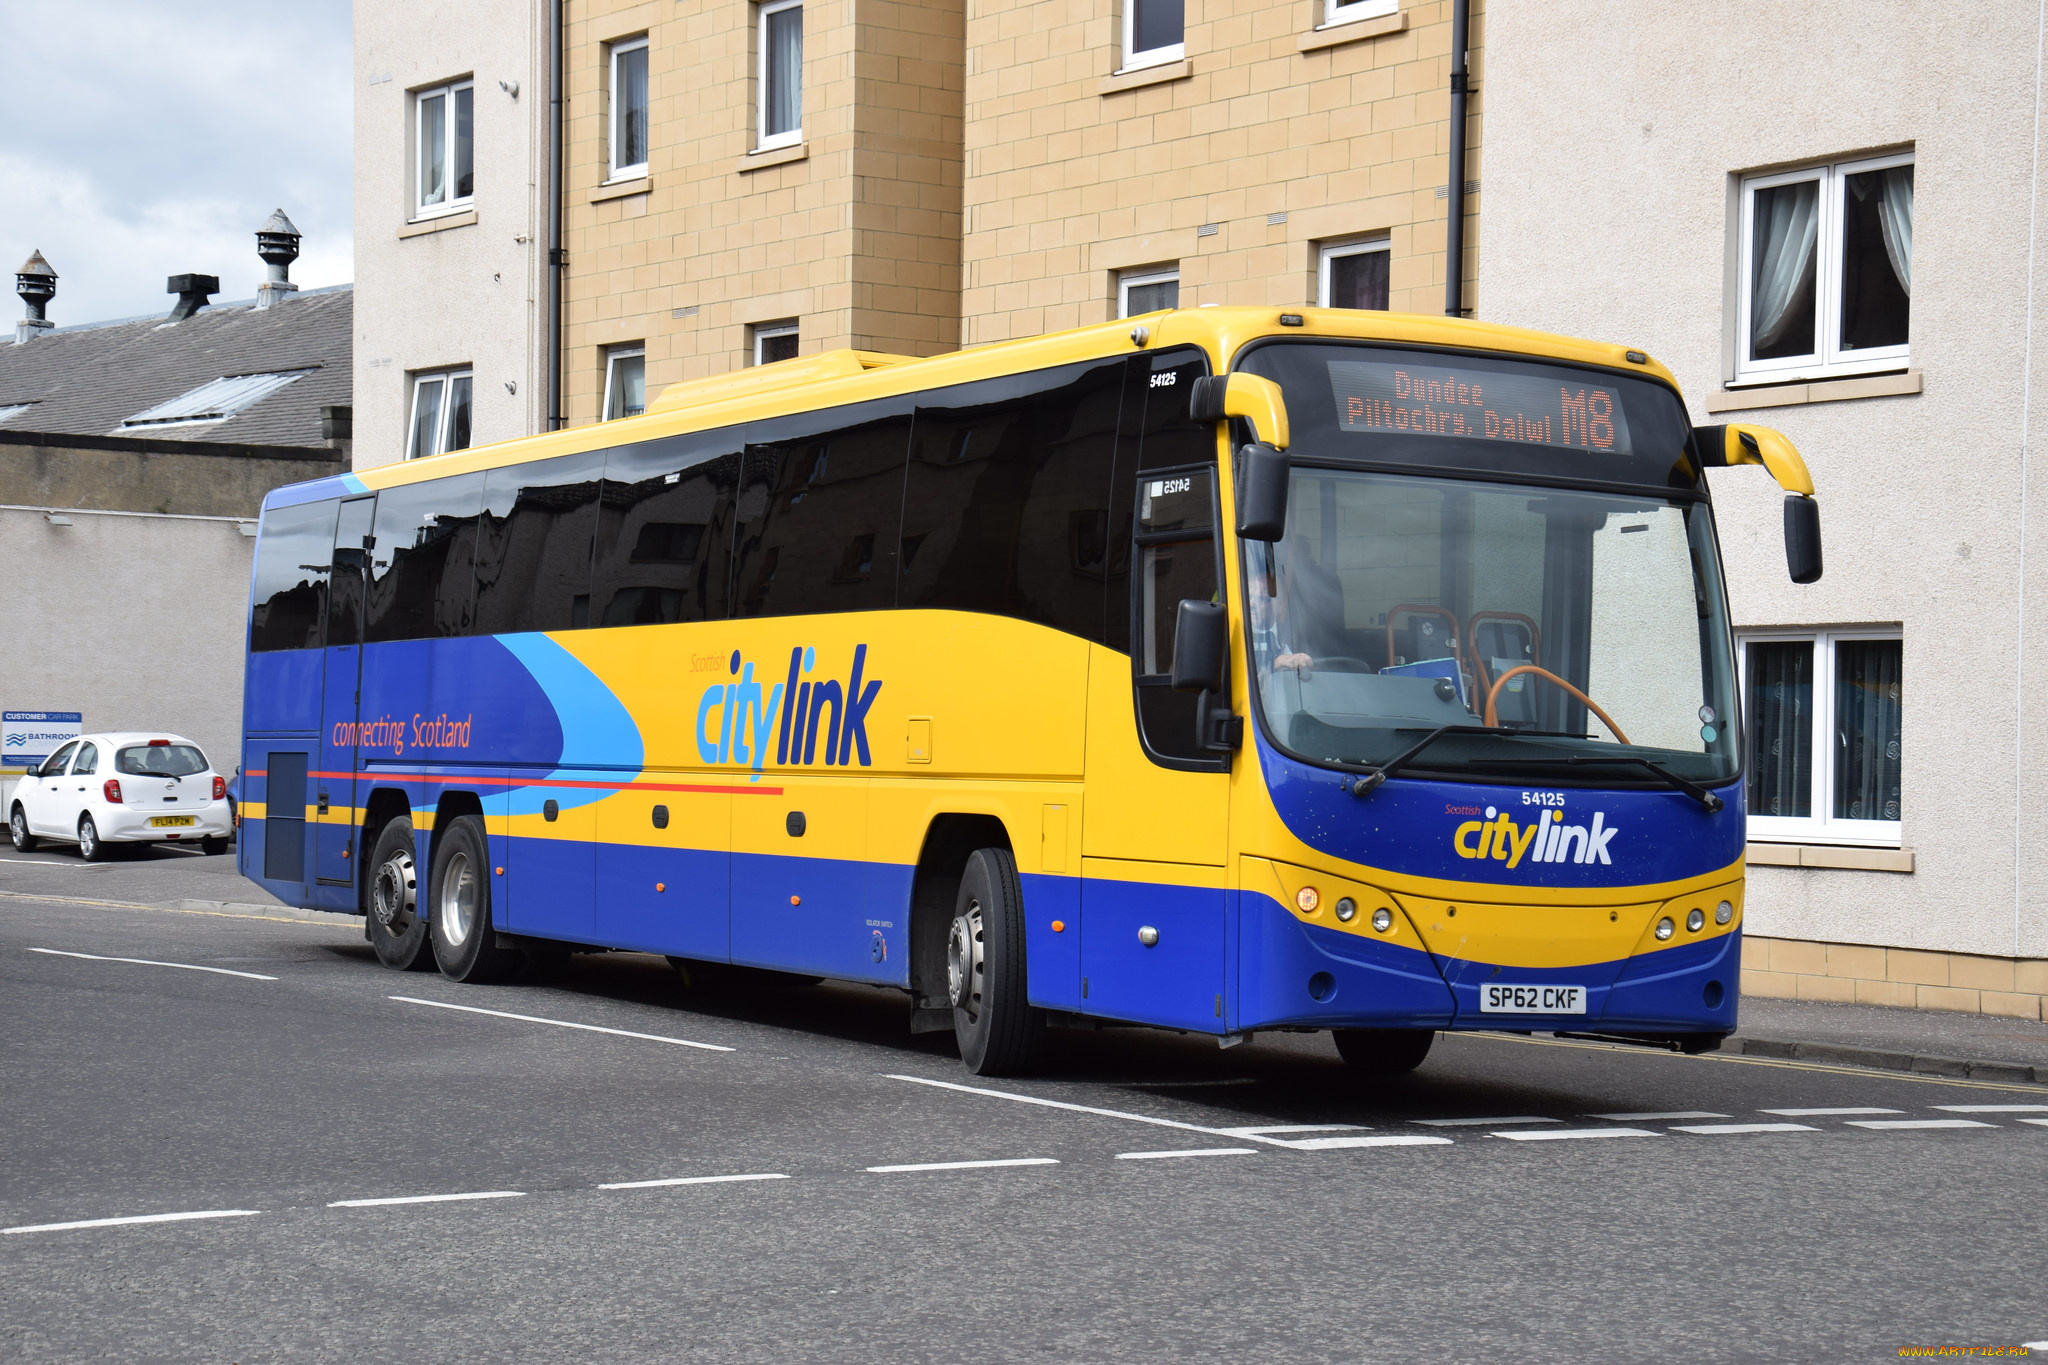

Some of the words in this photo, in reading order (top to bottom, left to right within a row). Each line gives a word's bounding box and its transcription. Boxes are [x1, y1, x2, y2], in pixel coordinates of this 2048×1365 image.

[1150, 372, 1176, 388] 54125
[1395, 371, 1483, 406] Dundee
[1561, 387, 1614, 447] M8
[689, 651, 726, 672] Scottish
[696, 644, 882, 782] citylink
[333, 714, 405, 755] connecting
[411, 713, 472, 748] Scotland
[1445, 804, 1481, 815] Scottish
[1522, 792, 1565, 806] 54125
[1454, 809, 1618, 868] citylink
[1489, 987, 1538, 1007] SP62
[1544, 988, 1578, 1008] CKF
